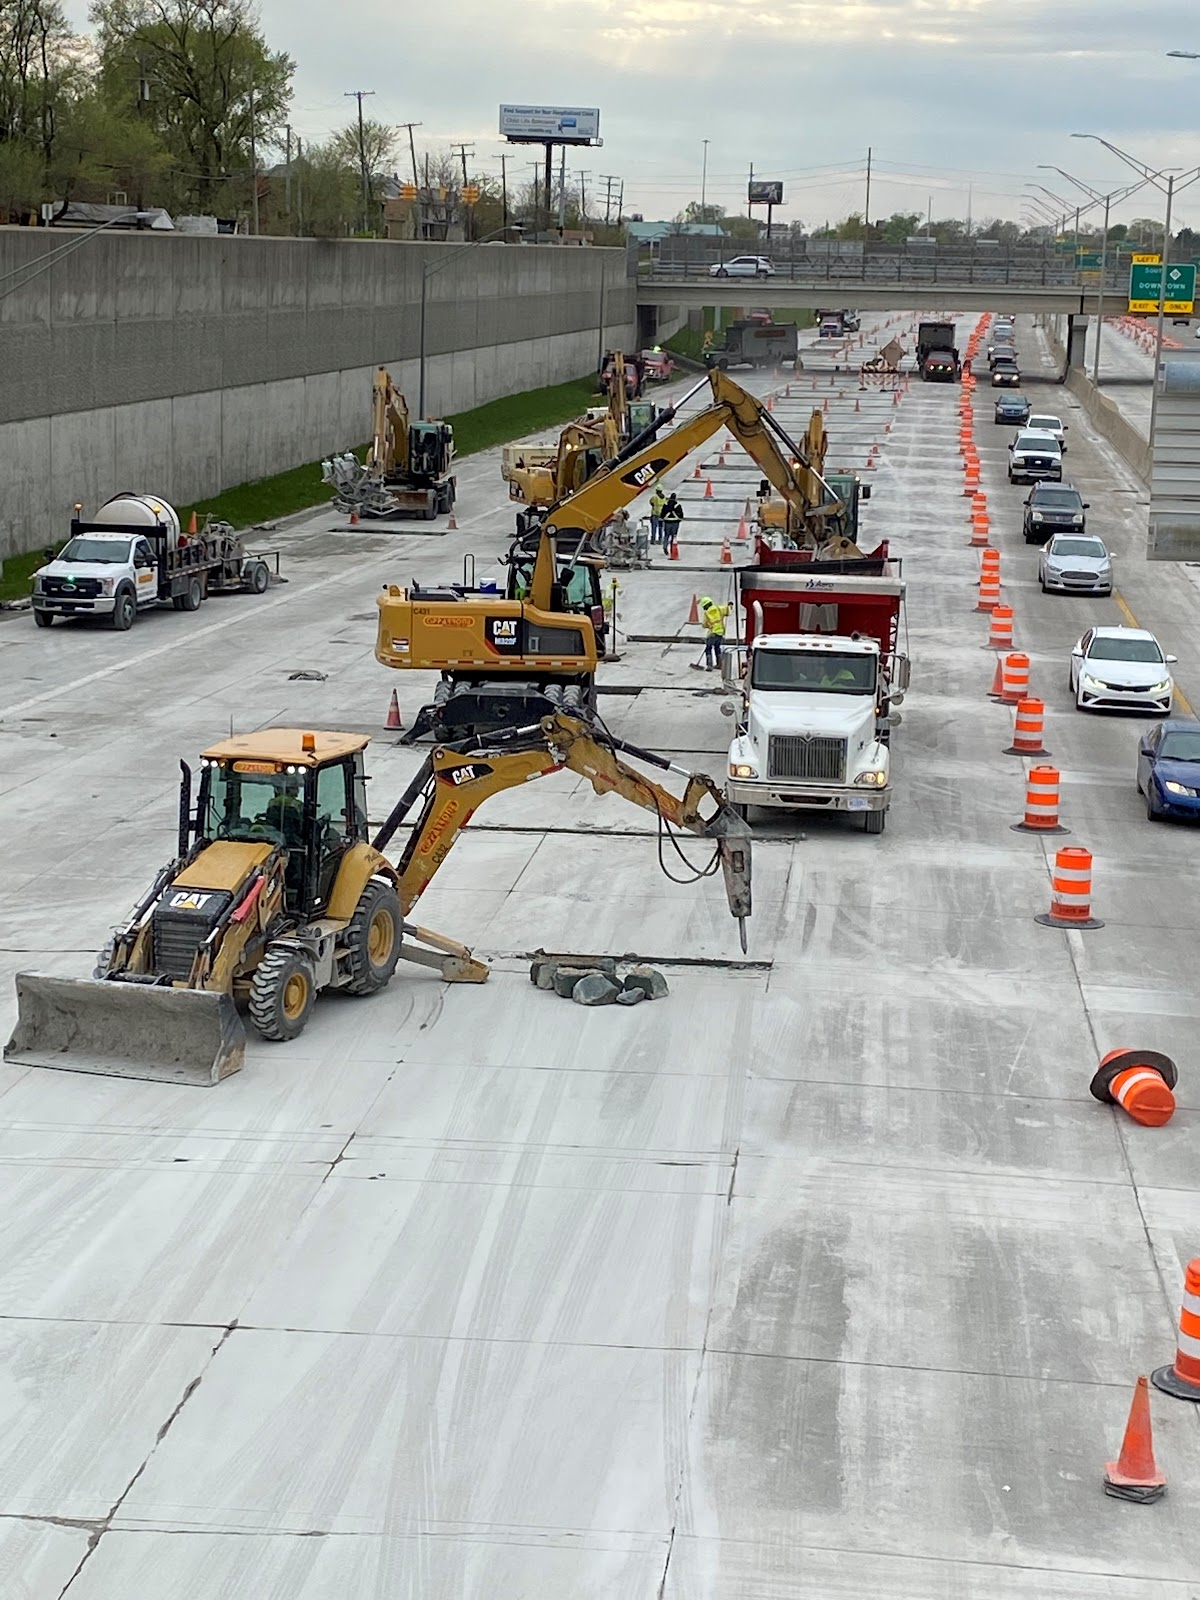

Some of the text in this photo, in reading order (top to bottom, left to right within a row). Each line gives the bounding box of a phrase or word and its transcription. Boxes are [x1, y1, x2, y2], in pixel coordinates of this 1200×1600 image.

[634, 463, 656, 485] CAT
[493, 620, 517, 636] CAT
[452, 765, 476, 785] CAT
[169, 891, 213, 910] CAT
